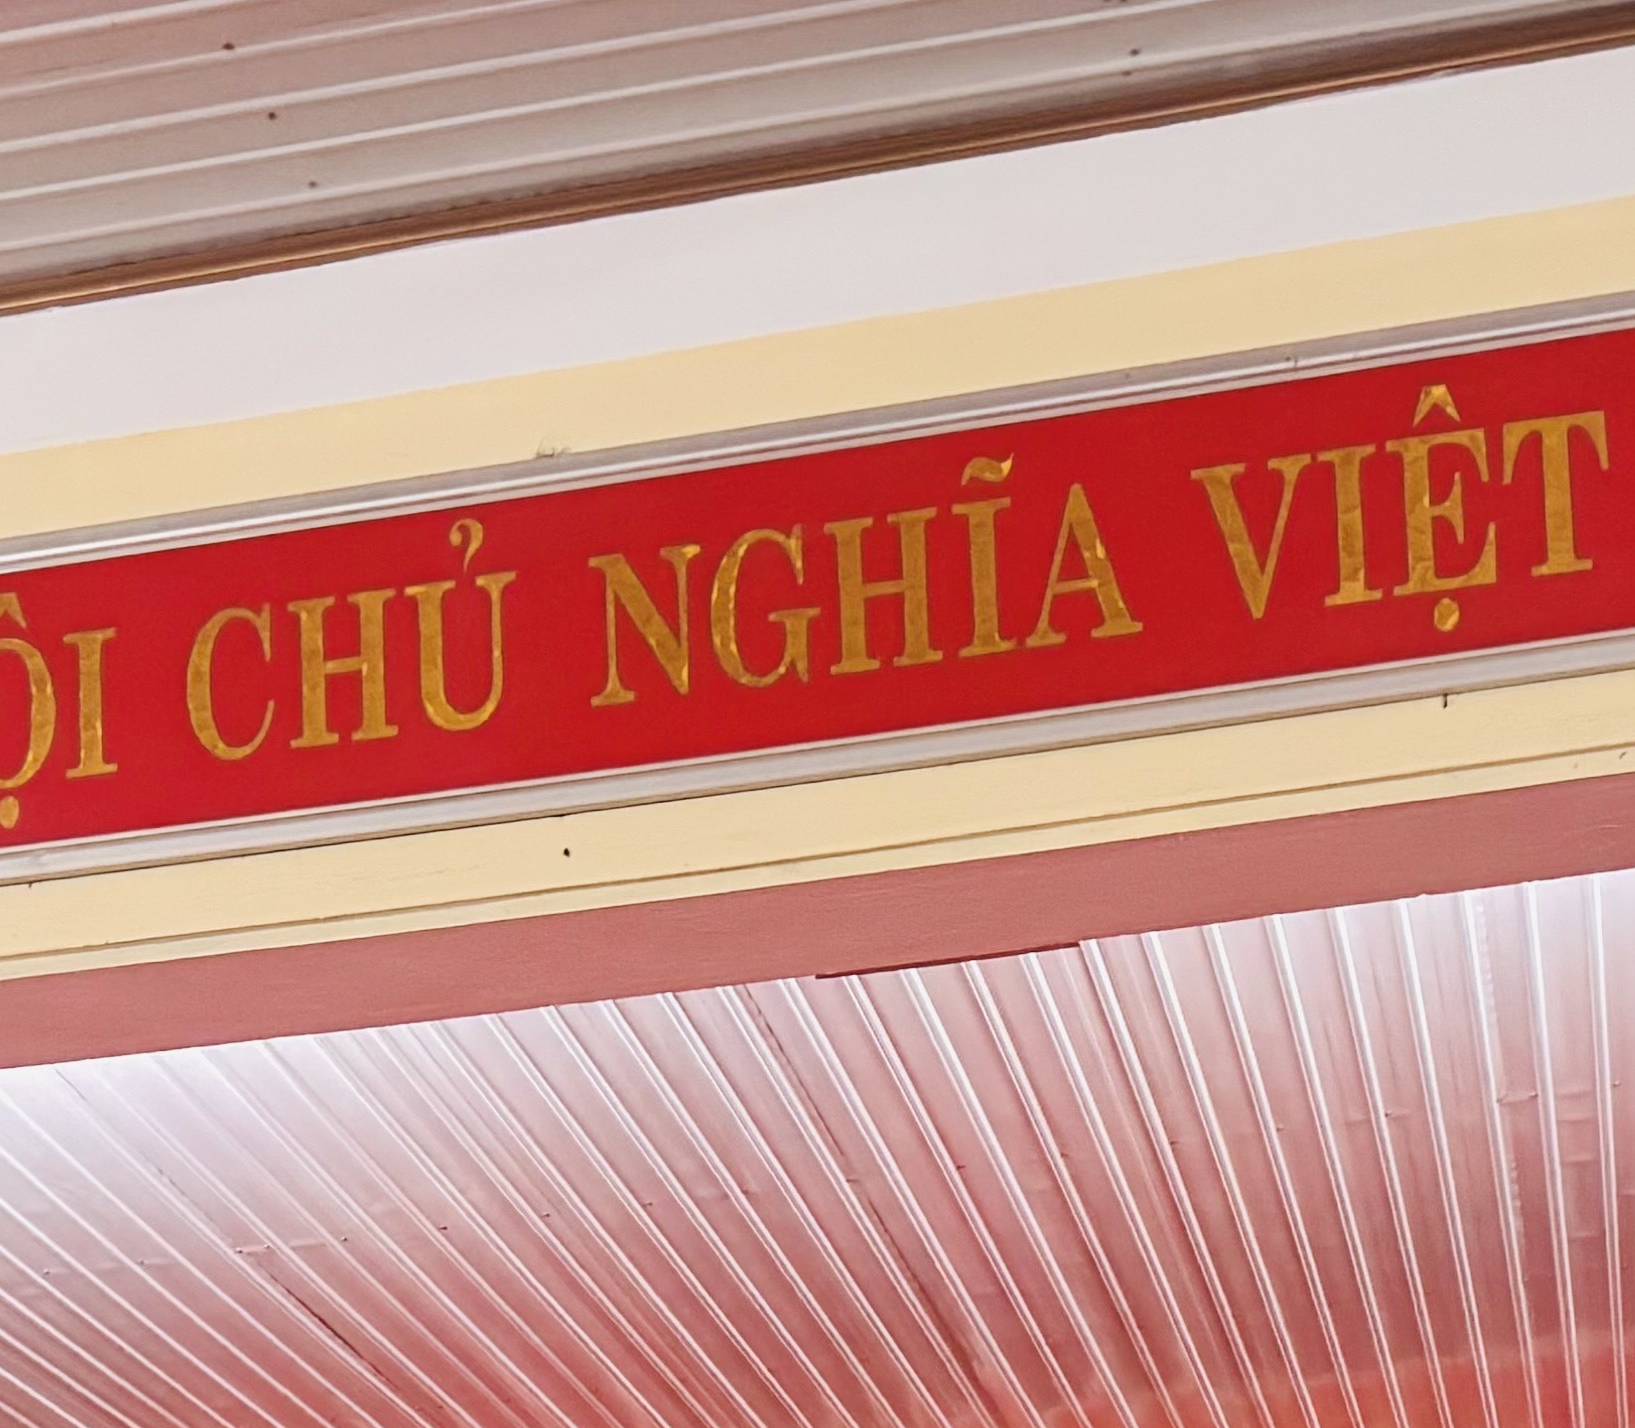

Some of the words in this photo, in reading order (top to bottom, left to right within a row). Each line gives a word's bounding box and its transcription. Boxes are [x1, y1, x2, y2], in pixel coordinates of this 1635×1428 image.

[186, 518, 516, 763] CHỦ
[589, 452, 1144, 708] NGHĨA
[1191, 384, 1609, 633] VIỆT
